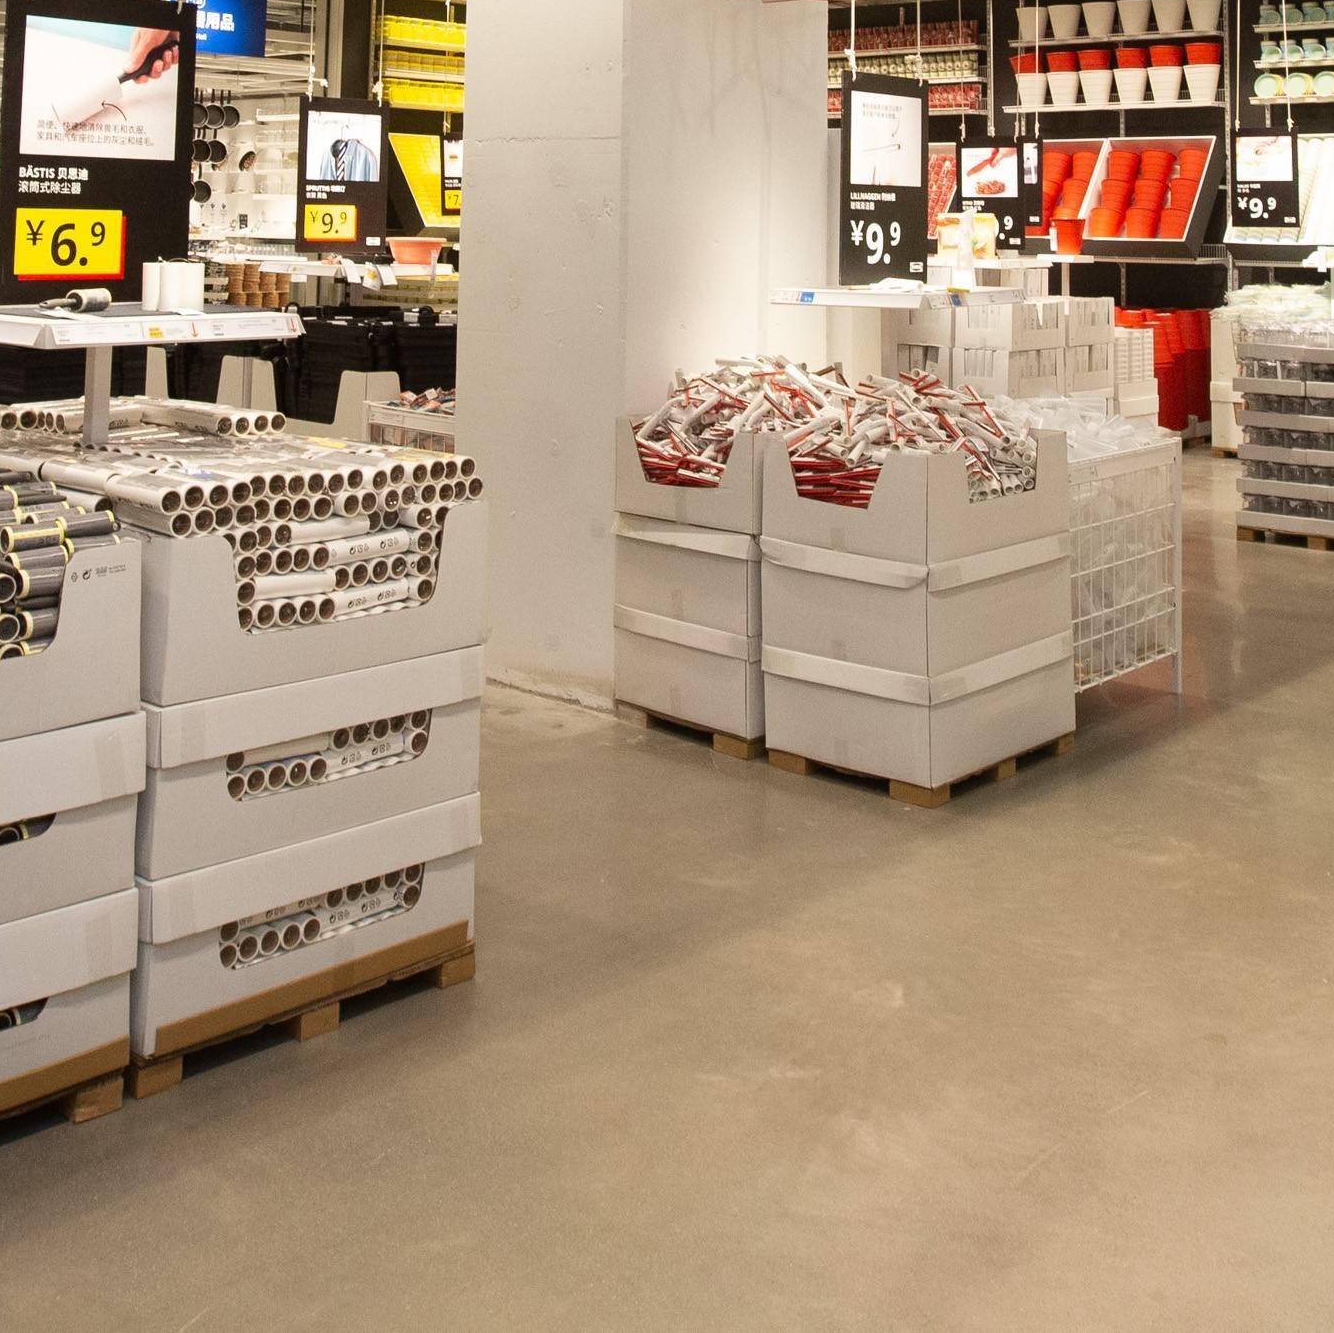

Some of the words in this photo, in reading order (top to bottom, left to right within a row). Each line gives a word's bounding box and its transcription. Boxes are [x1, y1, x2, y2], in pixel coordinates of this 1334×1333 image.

[18, 180, 81, 194] 滚筒式除尘器
